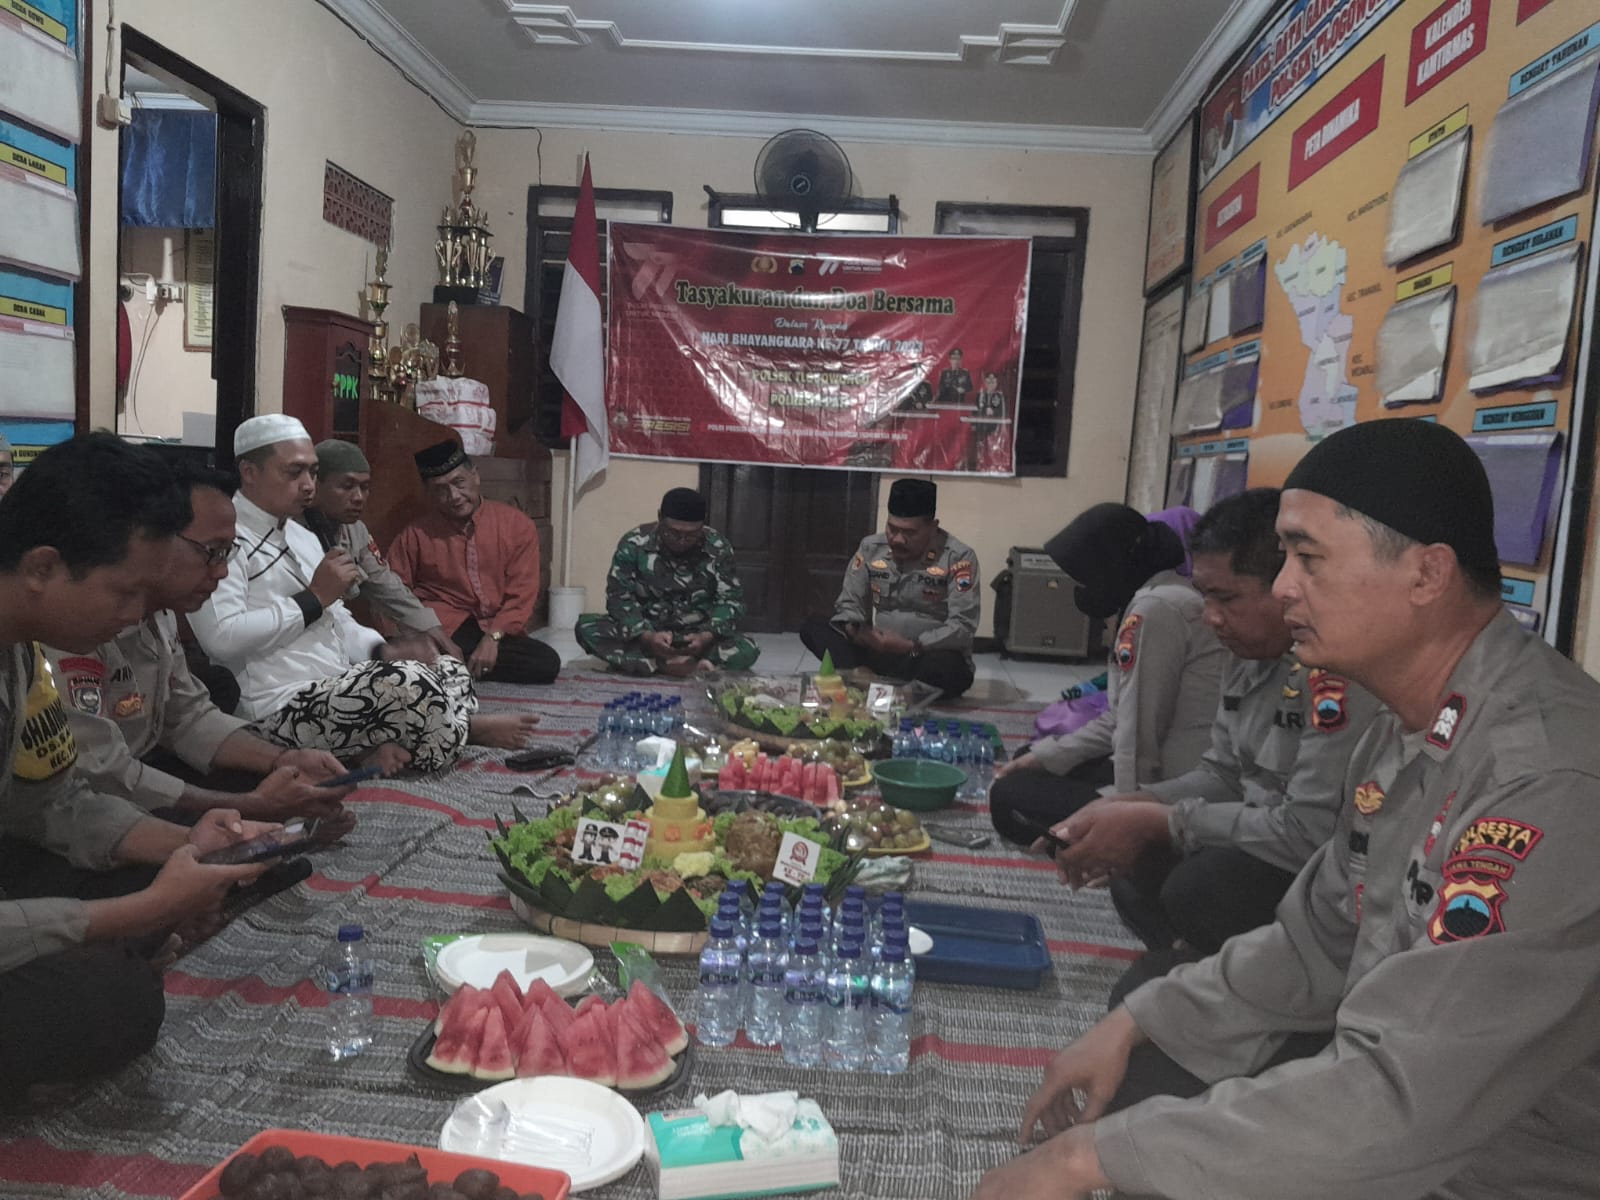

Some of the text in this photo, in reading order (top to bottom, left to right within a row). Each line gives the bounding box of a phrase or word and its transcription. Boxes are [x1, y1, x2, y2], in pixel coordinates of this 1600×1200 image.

[675, 279, 955, 315] Tasyakuran dan Doa Bersama
[701, 331, 729, 345] HARI
[731, 333, 814, 349] BHAYANGKARA
[752, 368, 792, 383] POLSEK
